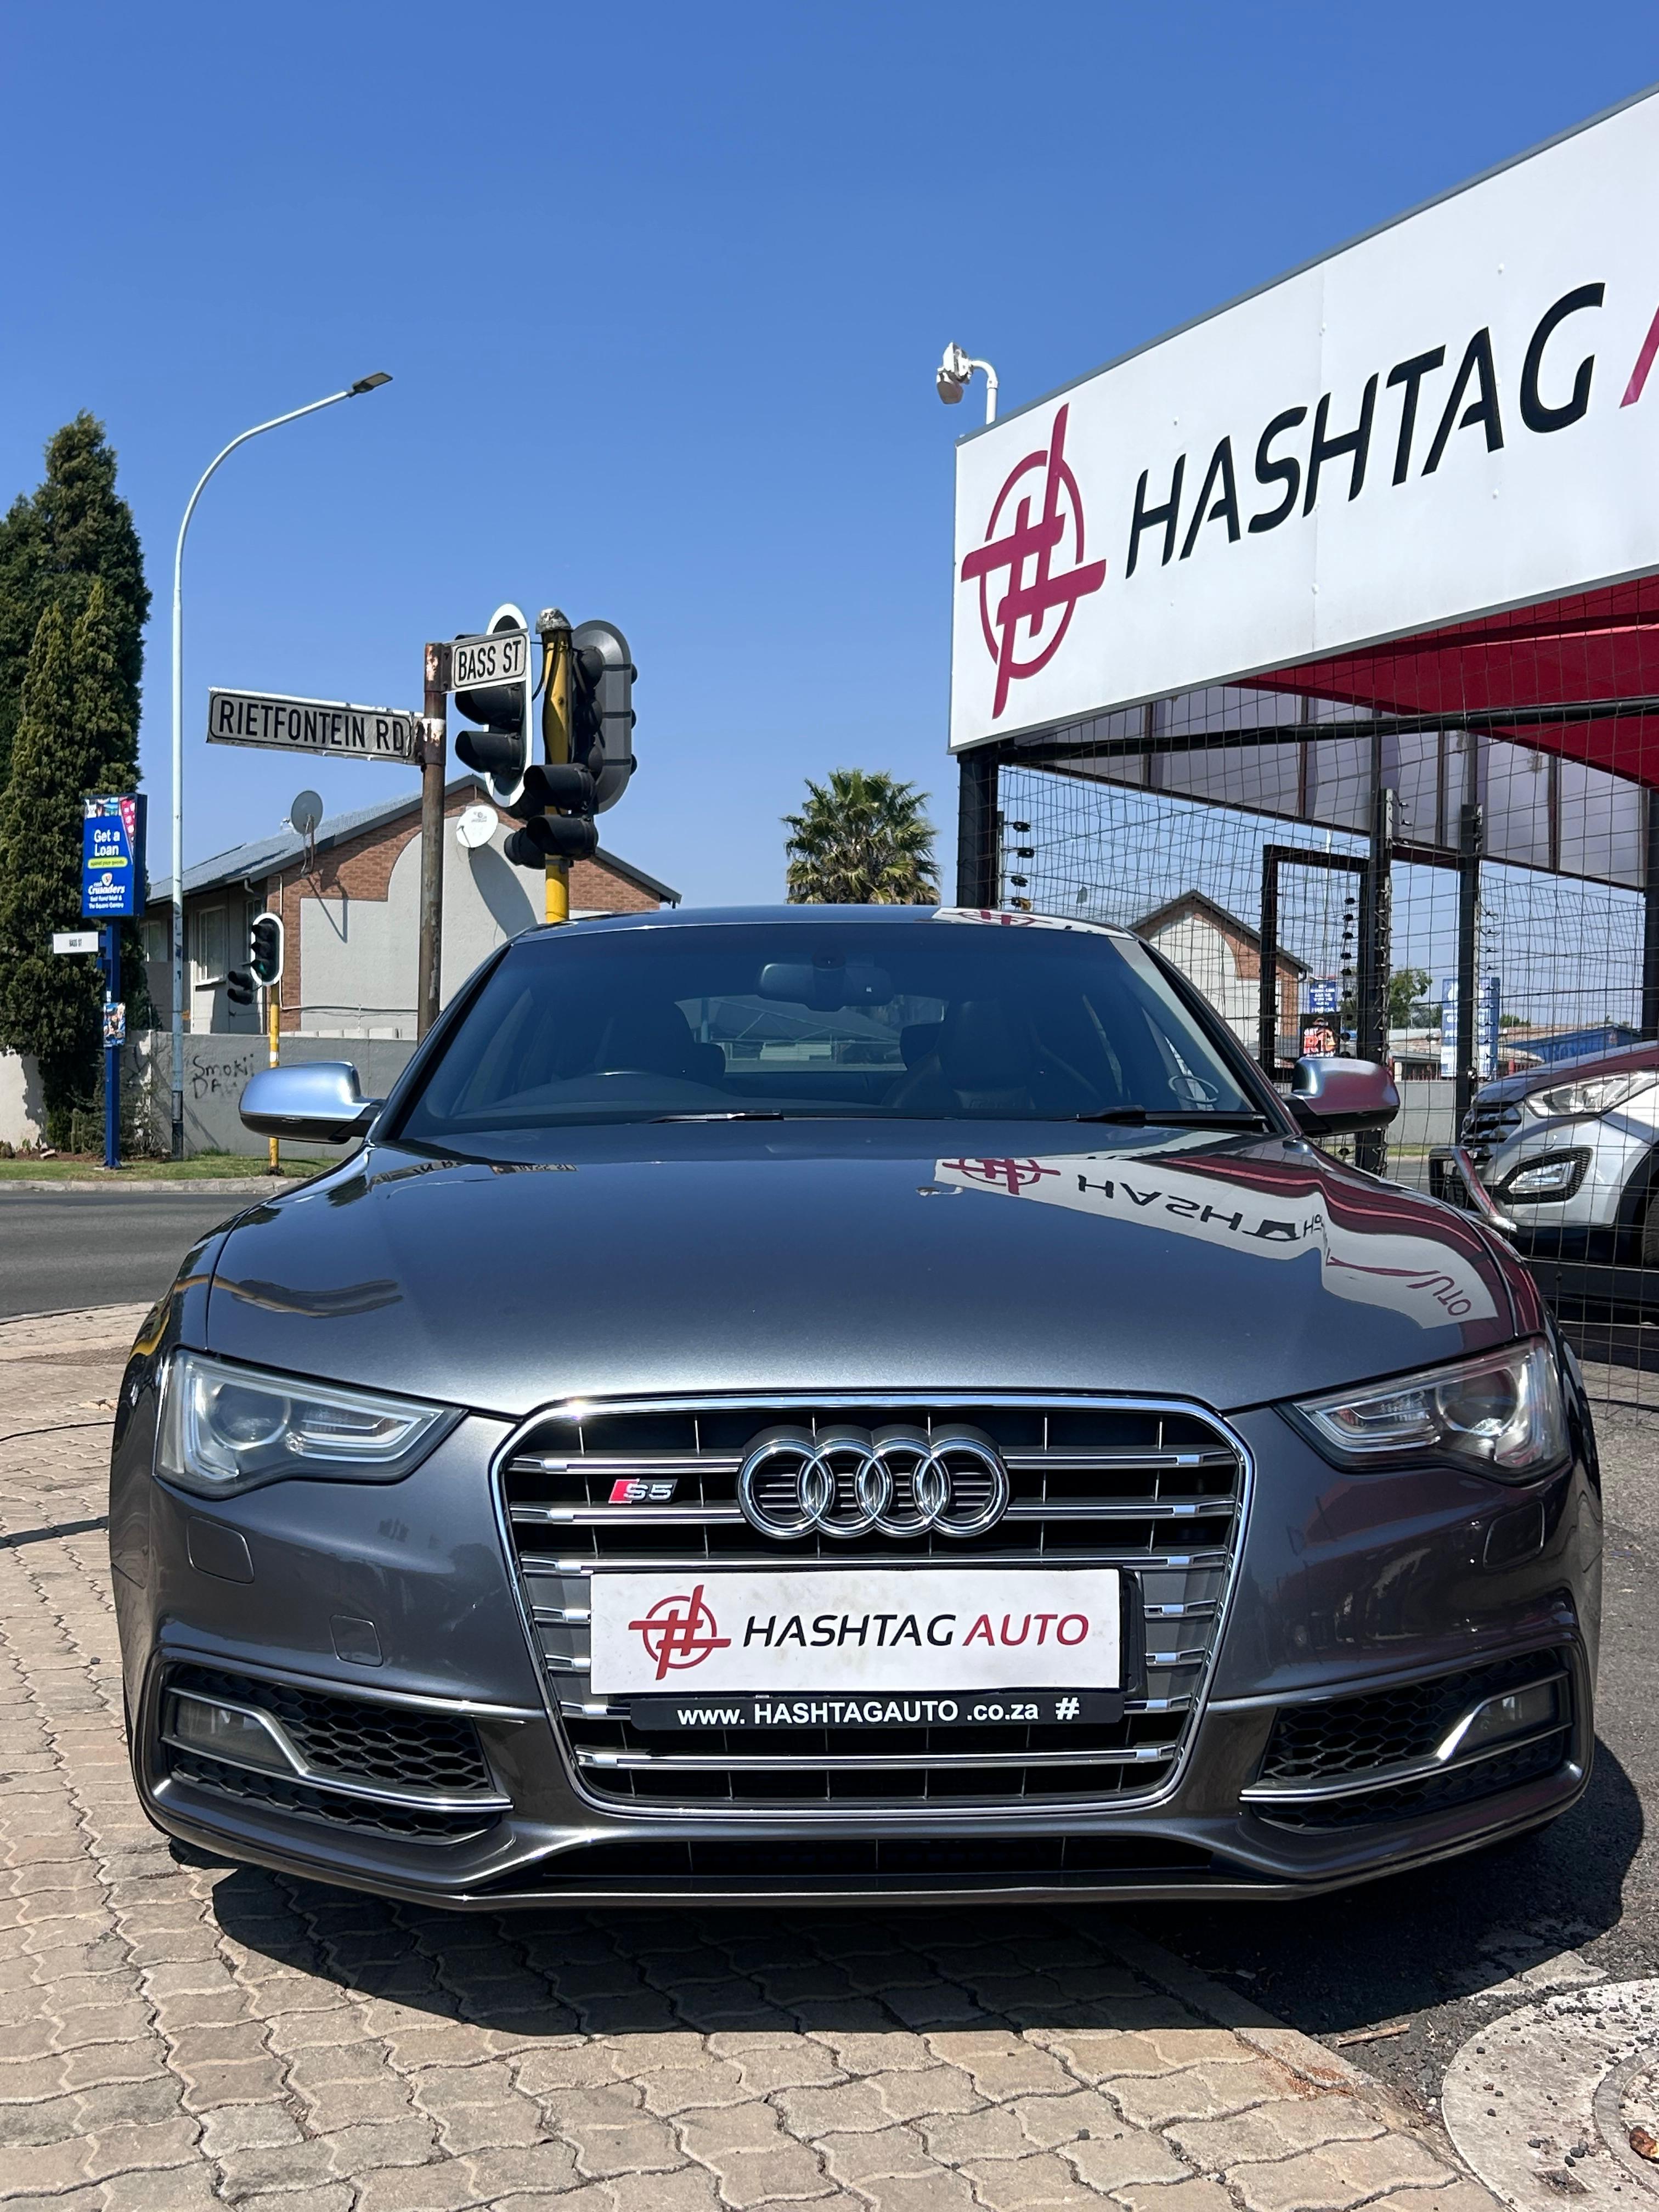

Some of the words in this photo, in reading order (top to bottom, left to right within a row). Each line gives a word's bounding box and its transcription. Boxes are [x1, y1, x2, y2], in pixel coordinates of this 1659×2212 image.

[1126, 283, 1606, 579] HASHTAG
[458, 646, 496, 681] BASS
[503, 641, 522, 673] ST
[219, 699, 366, 748] RIETFONTEIN
[376, 719, 405, 752] RD
[94, 829, 111, 843] Get
[113, 831, 120, 842] a
[94, 843, 120, 856] Loan
[623, 1483, 673, 1500] S5
[743, 1614, 956, 1647] HASHTAG
[962, 1614, 1089, 1646] AUTO
[677, 1708, 745, 1725] www.
[754, 1699, 959, 1724] HASHTAGAUTO
[967, 1703, 1039, 1721] .co.za
